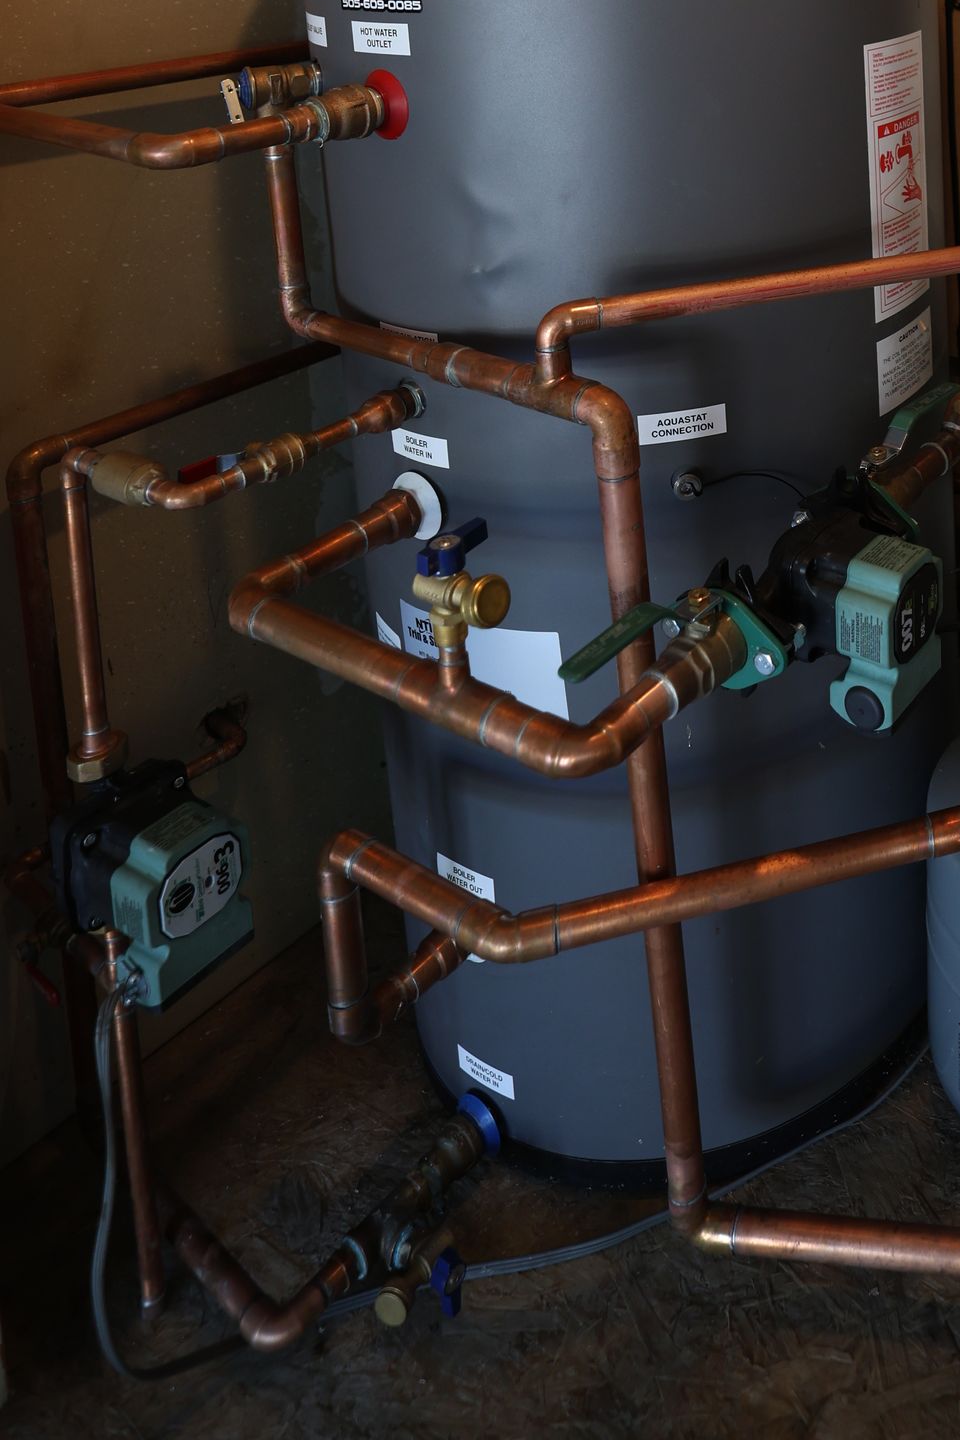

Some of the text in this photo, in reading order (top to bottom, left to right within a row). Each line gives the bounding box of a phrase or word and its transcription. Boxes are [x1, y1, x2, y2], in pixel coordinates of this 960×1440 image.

[360, 27, 398, 38] HOT WATER
[366, 38, 392, 49] OUTLET
[893, 112, 919, 134] DANGER
[898, 324, 919, 343] CAUTION
[657, 413, 708, 427] AQUASTAT
[651, 422, 714, 438] CONNECTION
[405, 435, 428, 448] BOILER
[403, 444, 433, 460] WATER IN
[415, 617, 433, 633] NTI
[452, 866, 476, 883] BOILER
[446, 872, 484, 895] WATER OUT
[470, 1066, 500, 1088] WATER IN
